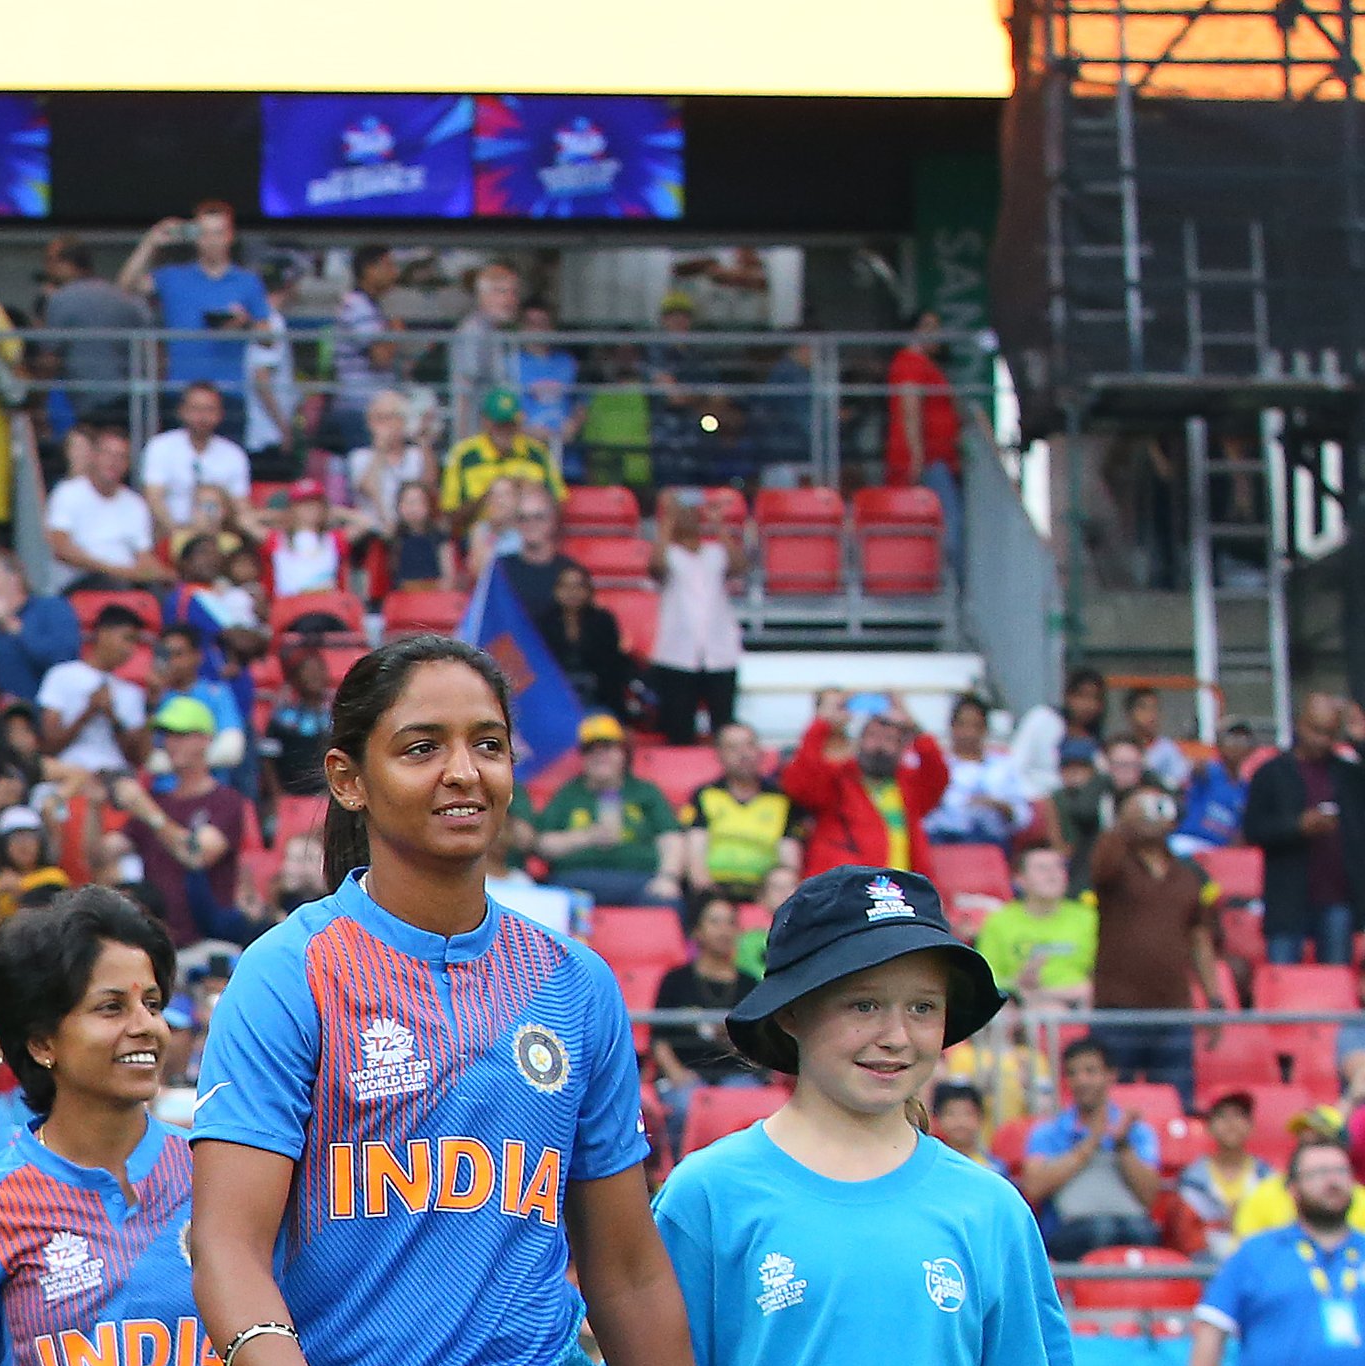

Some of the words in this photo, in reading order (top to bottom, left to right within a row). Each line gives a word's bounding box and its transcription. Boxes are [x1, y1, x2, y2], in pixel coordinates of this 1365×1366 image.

[348, 1062, 406, 1083] WOMEN'S
[405, 1059, 431, 1073] T20
[356, 1076, 400, 1092] WORLD
[401, 1072, 425, 1085] CUP
[358, 1086, 404, 1100] AUSTRALIA
[405, 1082, 427, 1092] 2020
[329, 1135, 561, 1228] INDIA
